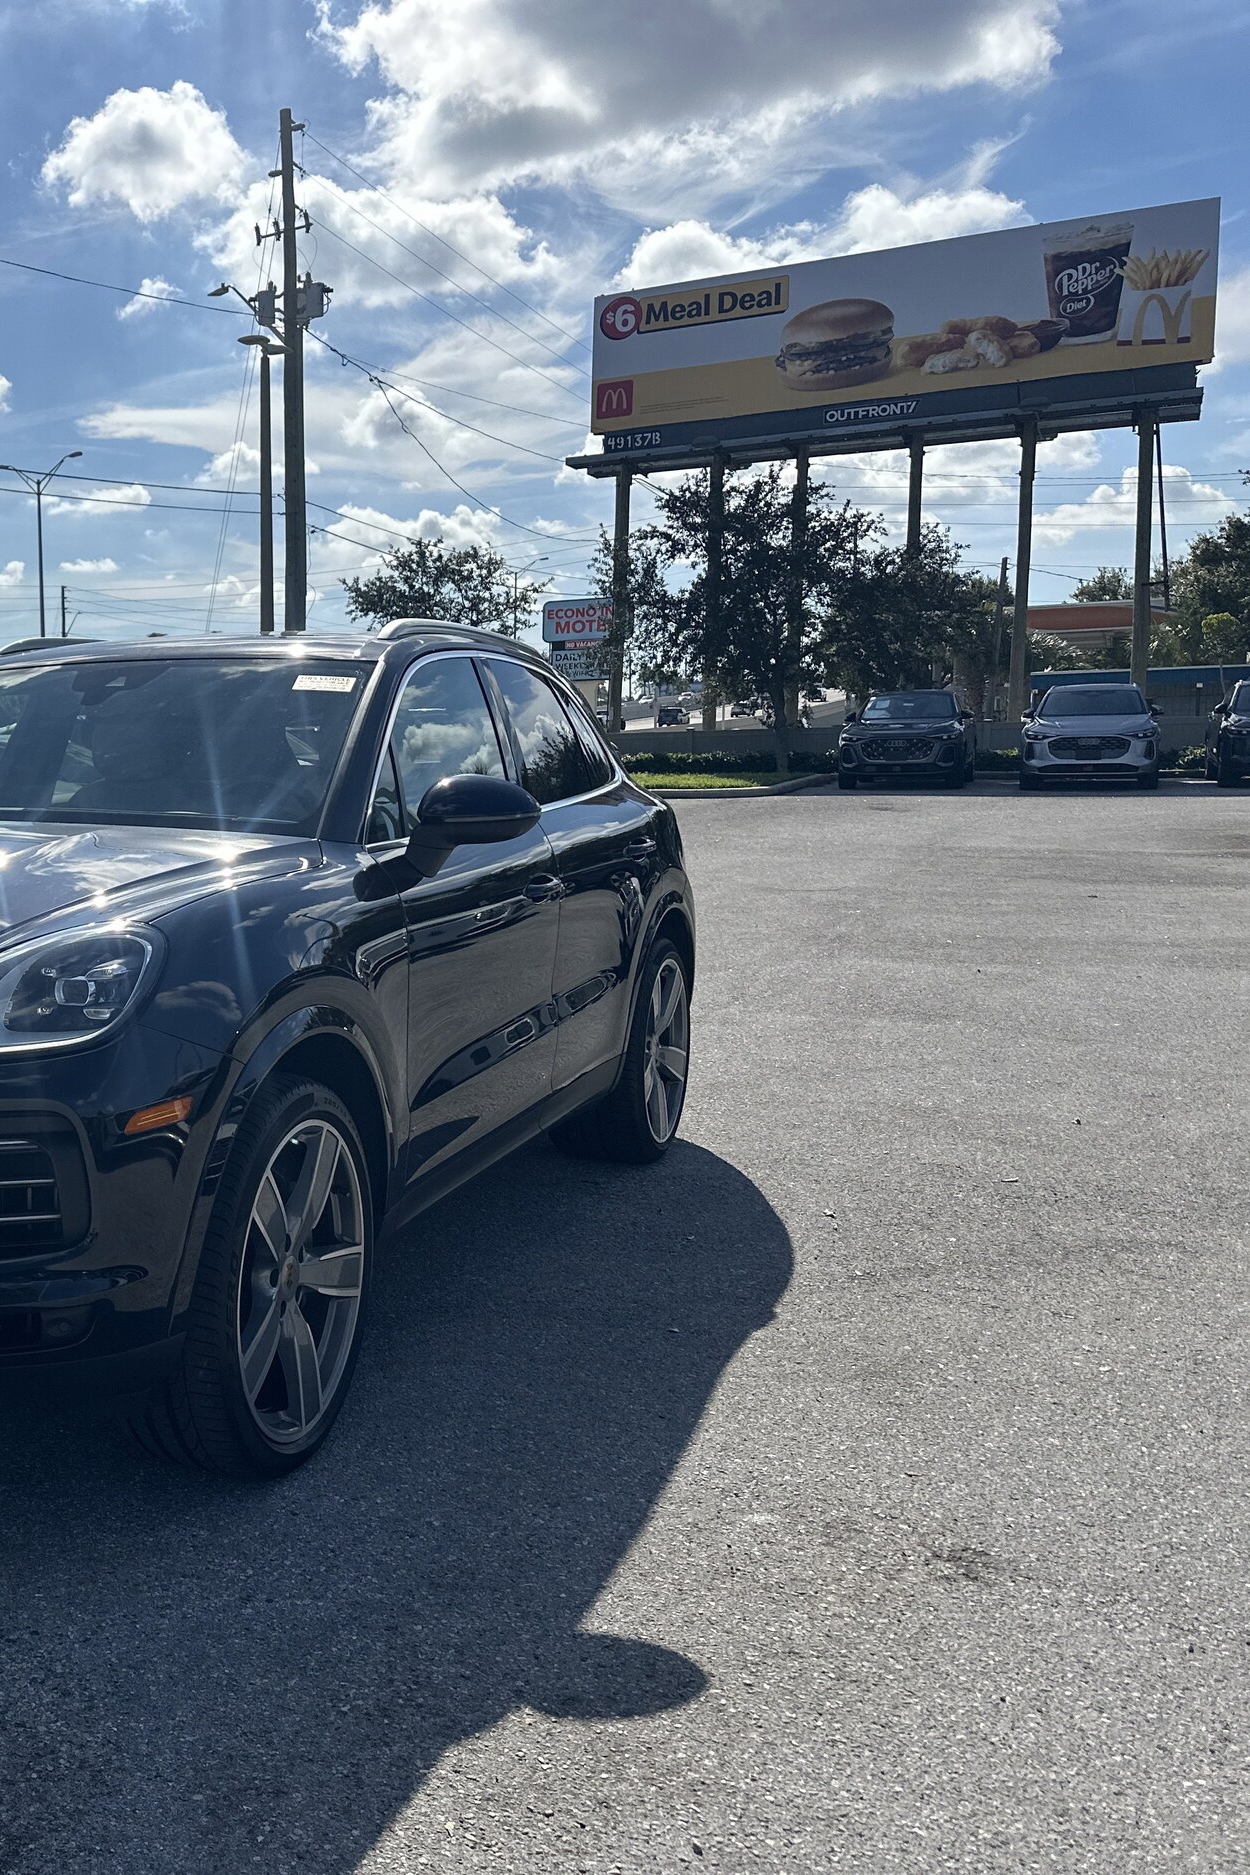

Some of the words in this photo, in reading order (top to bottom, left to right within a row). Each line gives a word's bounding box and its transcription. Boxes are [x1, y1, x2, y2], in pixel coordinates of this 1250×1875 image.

[1077, 262, 1100, 280] Dr
[1056, 264, 1114, 297] Pepper
[605, 304, 636, 333] $6
[644, 293, 710, 325] Meal
[718, 282, 782, 314] Deal
[1066, 299, 1087, 313] Diet
[547, 607, 597, 620] ECONO
[600, 606, 614, 617] IN
[555, 620, 607, 634] MOTE
[576, 640, 600, 648] VACANC
